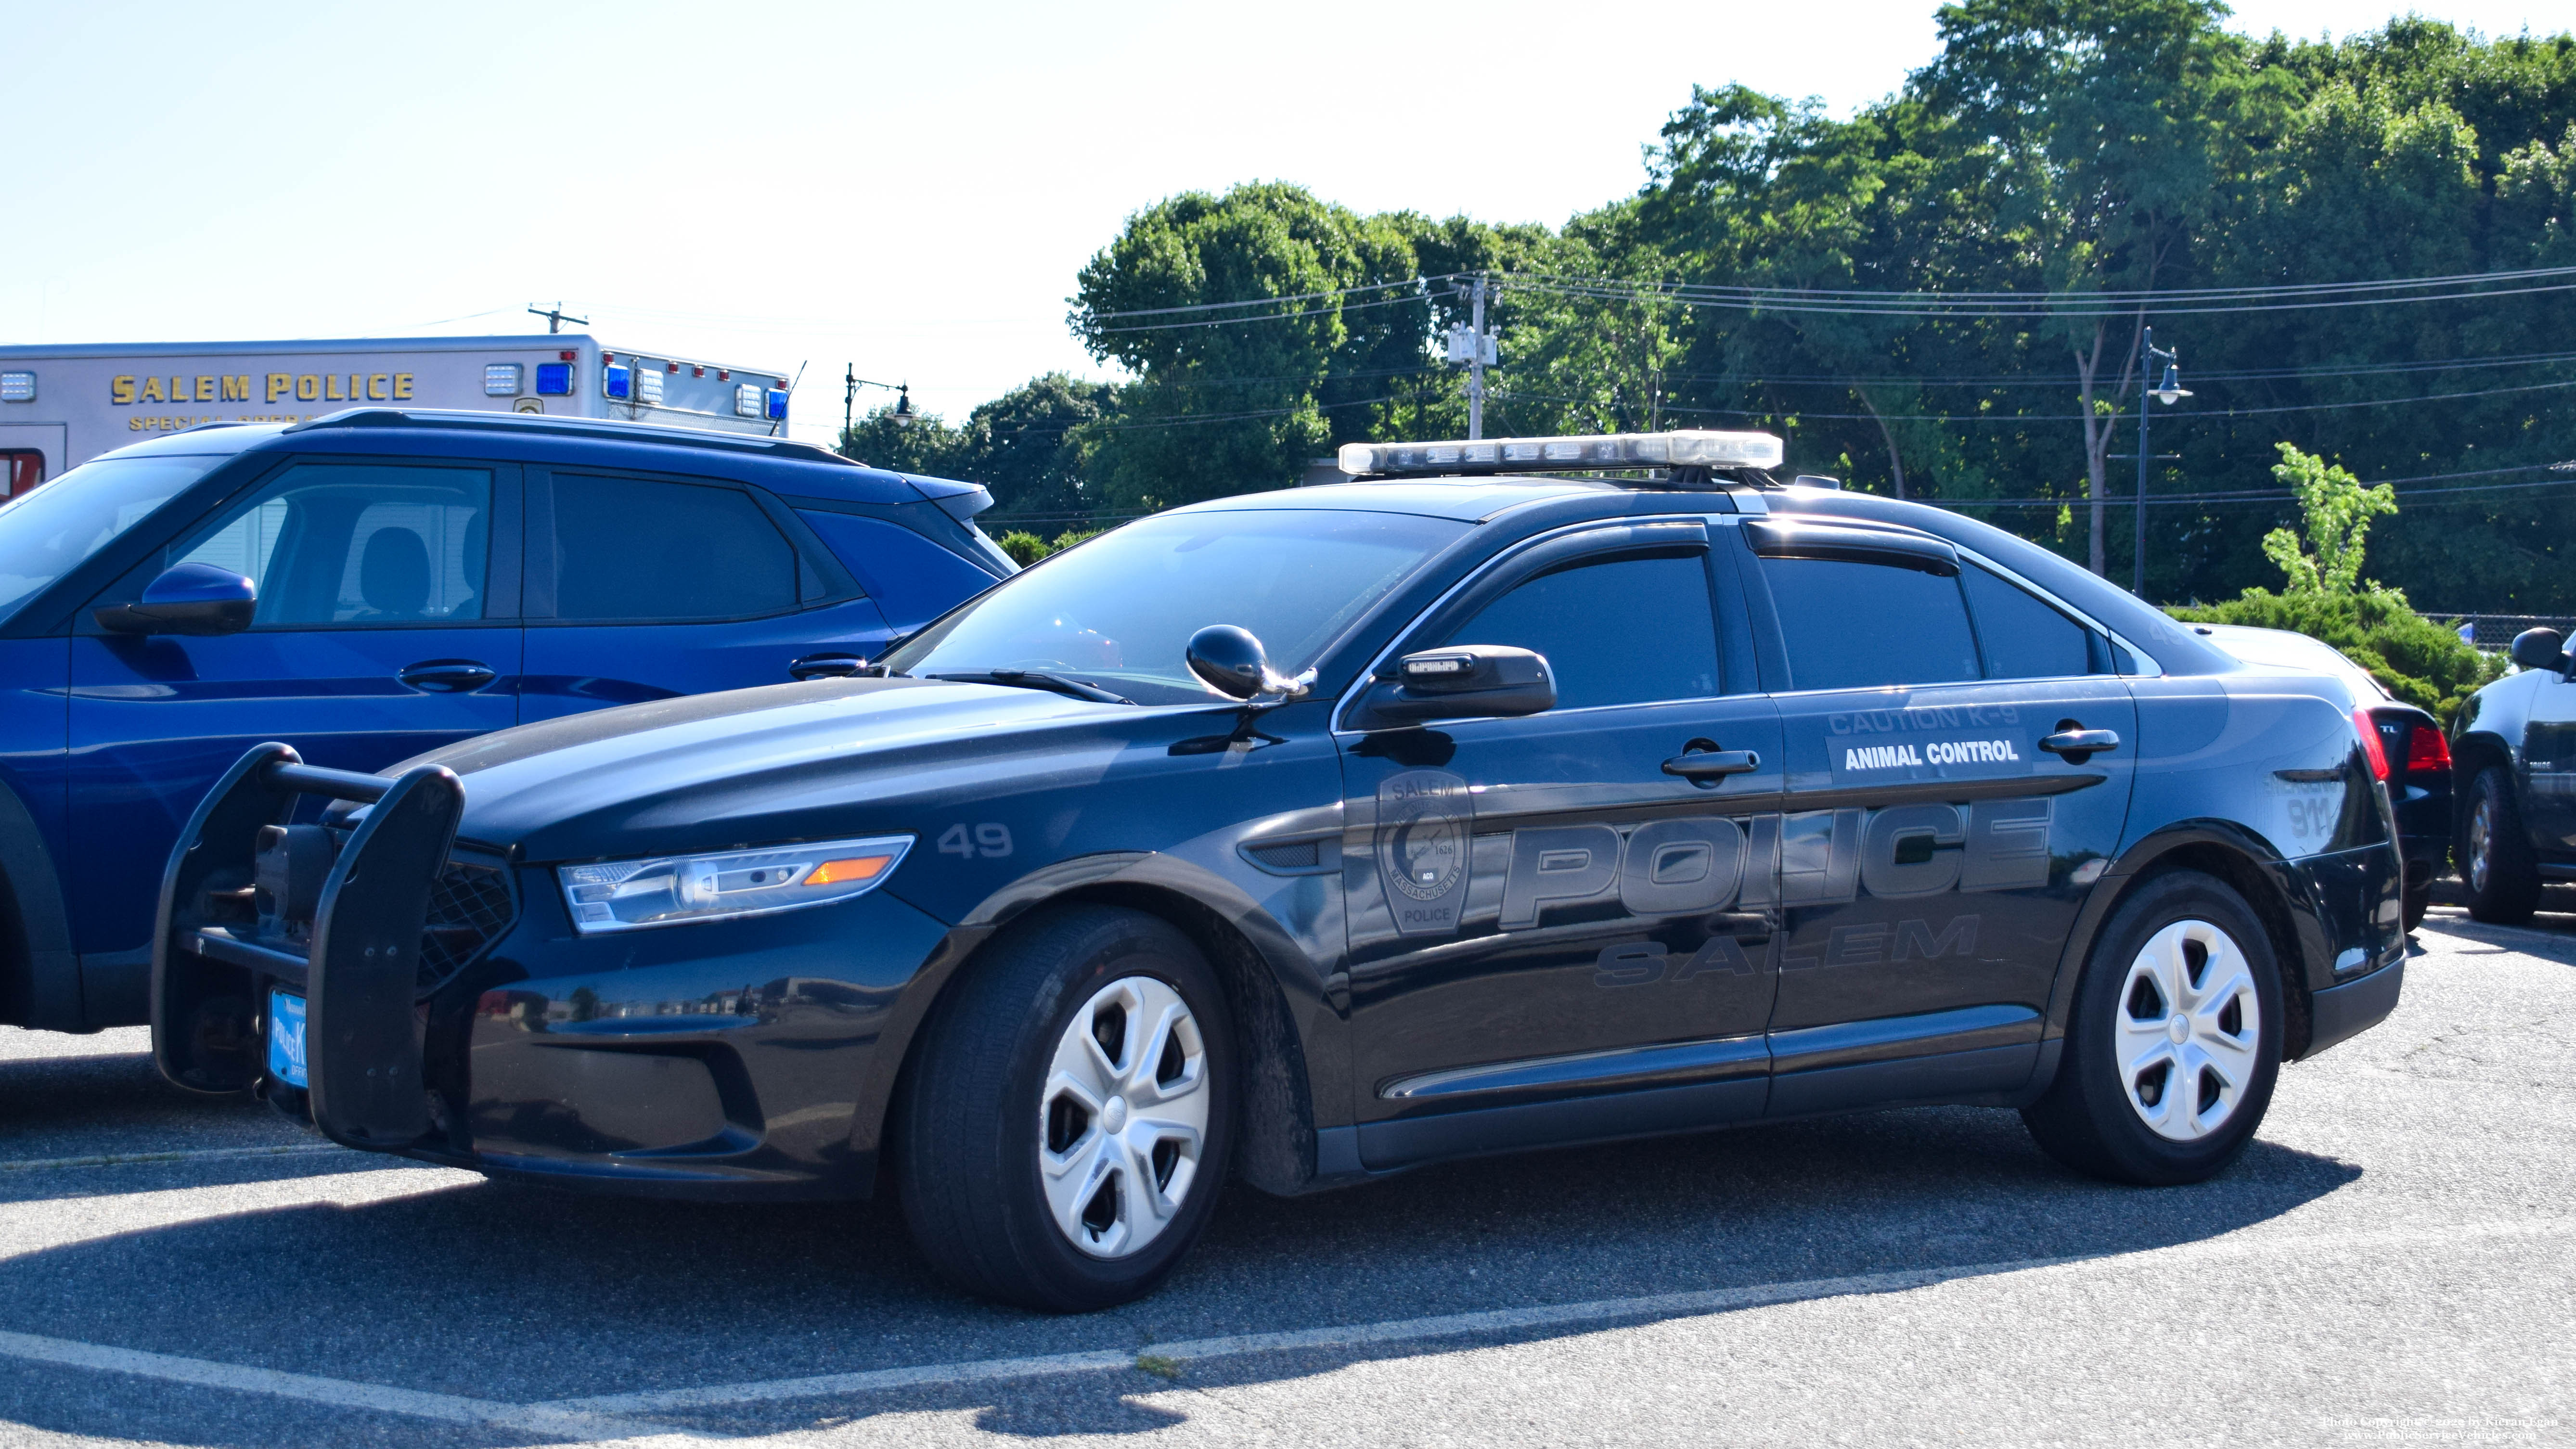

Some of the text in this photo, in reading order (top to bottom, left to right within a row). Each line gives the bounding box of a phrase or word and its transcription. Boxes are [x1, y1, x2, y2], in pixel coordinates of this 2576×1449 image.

[112, 372, 414, 405] SALEM POLICE
[2149, 620, 2185, 645] 49
[1829, 705, 2020, 735] CAUTION K-9
[2379, 725, 2398, 733] TL
[1846, 740, 2019, 770] ANIMAL CONTROL
[1392, 780, 1455, 800] SALEM
[2287, 798, 2332, 838] 911
[938, 822, 1013, 859] 49
[1435, 845, 1453, 855] 1626
[1498, 795, 2052, 930] POLICE
[1390, 866, 1460, 899] MASSACHUSETTS
[1404, 908, 1450, 923] POLICE
[1593, 914, 1981, 987] SALEM
[275, 1016, 296, 1062] POLICE
